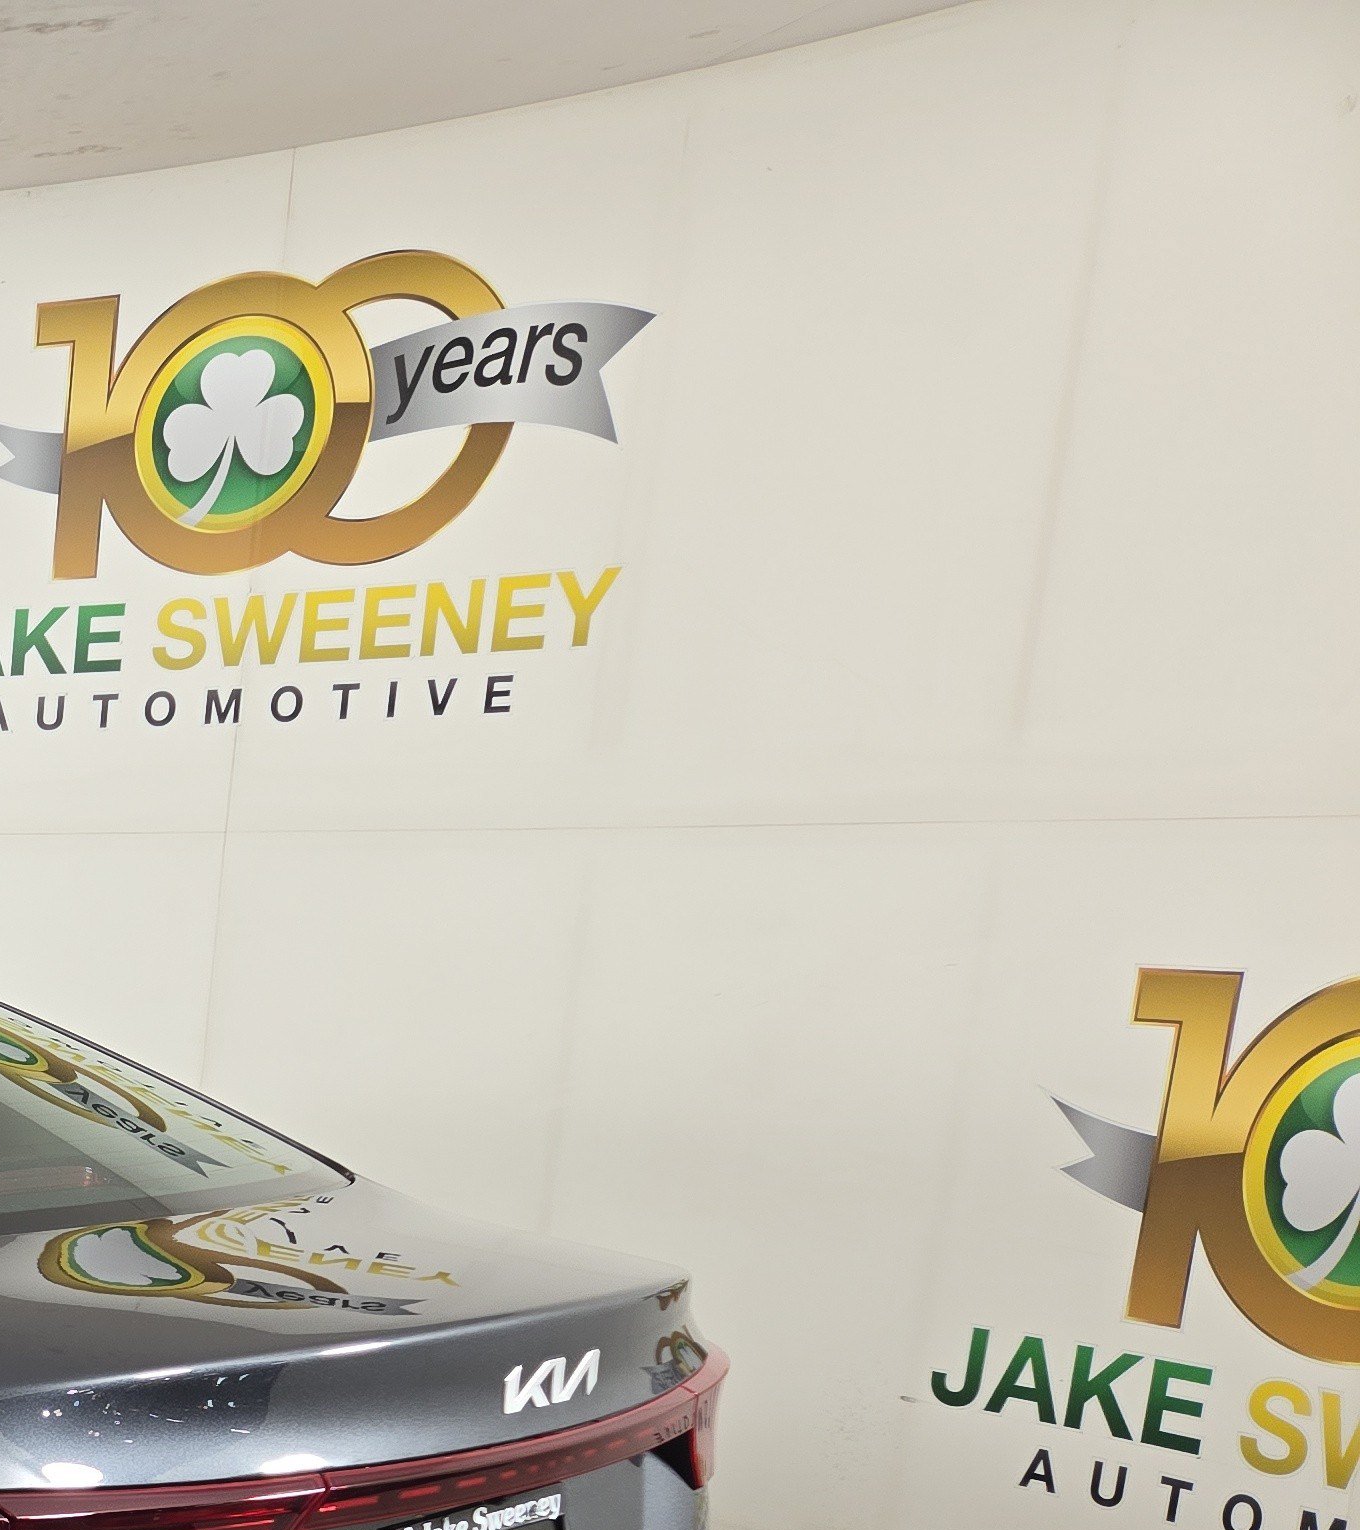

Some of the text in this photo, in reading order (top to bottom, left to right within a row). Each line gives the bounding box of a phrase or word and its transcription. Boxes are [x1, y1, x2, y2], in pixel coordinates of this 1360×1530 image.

[36, 249, 516, 581] 100
[385, 320, 589, 426] years
[152, 565, 624, 671] SWEENEY
[503, 1348, 601, 1415] KIA
[931, 1327, 1214, 1456] JAKE
